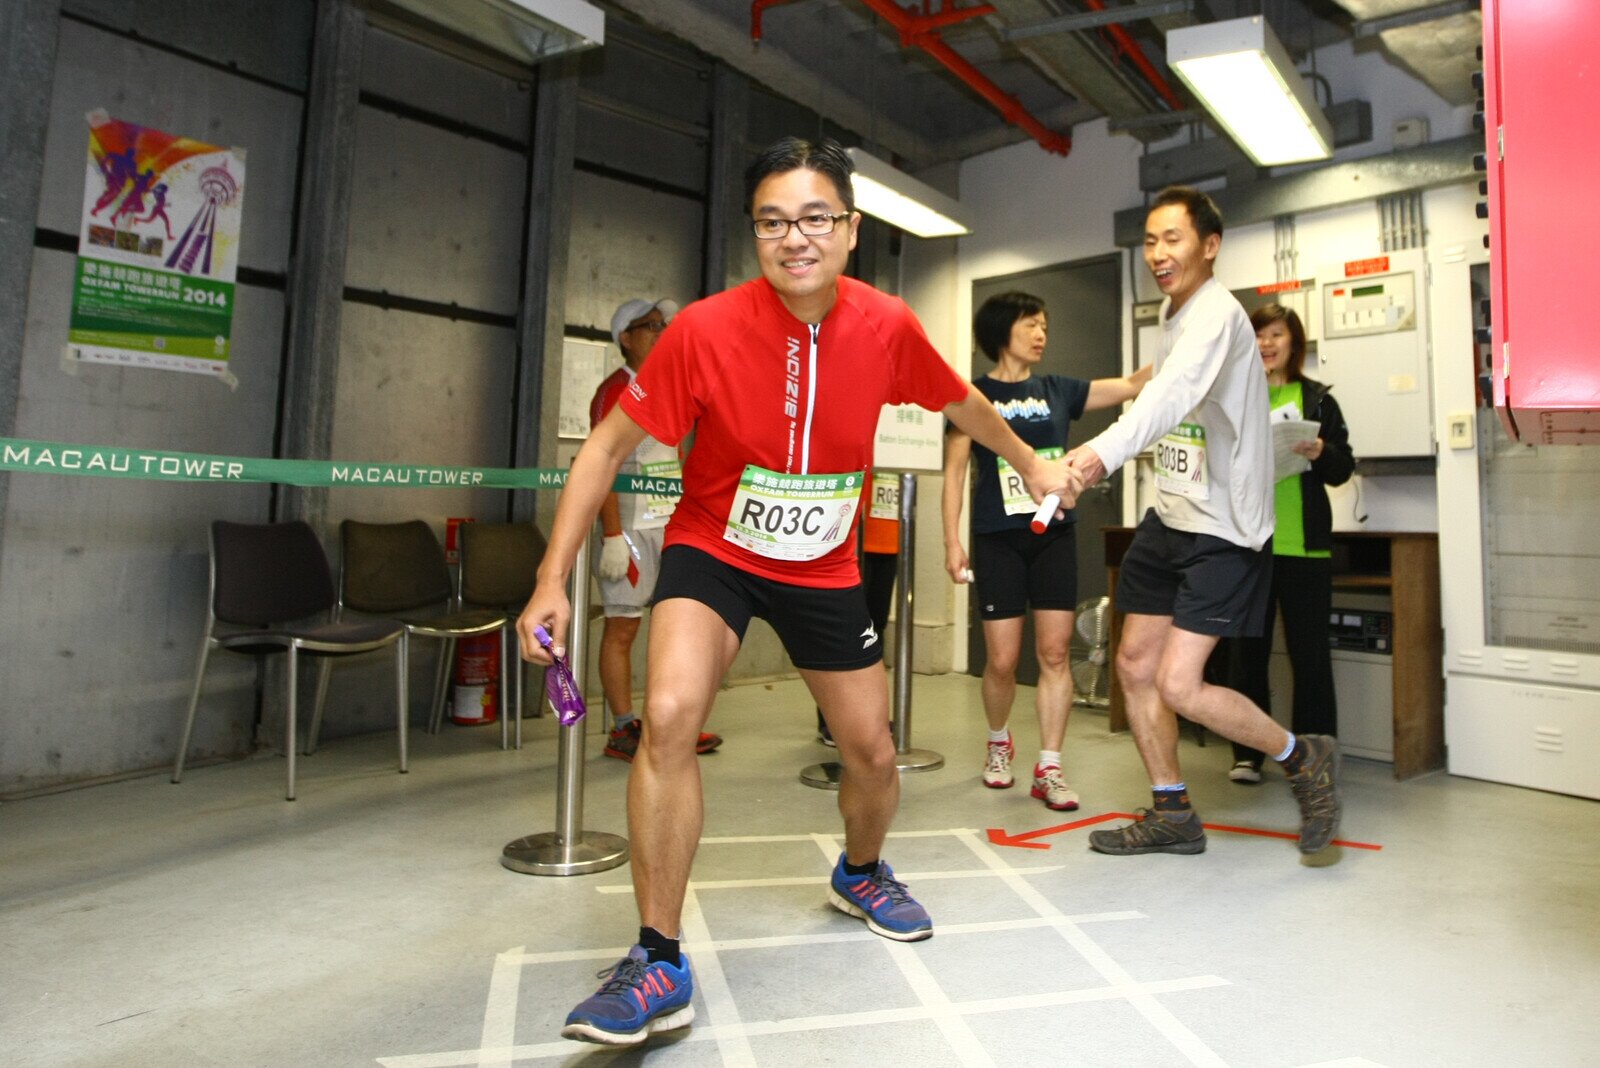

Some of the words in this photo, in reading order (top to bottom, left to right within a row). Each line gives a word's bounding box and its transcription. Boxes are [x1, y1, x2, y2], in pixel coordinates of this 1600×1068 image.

[81, 275, 121, 291] OXFAM
[123, 282, 180, 300] TOWERRUN
[183, 287, 227, 308] 2014
[3, 445, 130, 472] MACAU
[139, 455, 244, 479] TOWER
[1158, 443, 1188, 473] R03B
[332, 466, 411, 483] MACAU
[415, 469, 484, 485] TOWER
[750, 484, 785, 497] OXFAM
[786, 489, 836, 498] TOWERRUN
[876, 487, 900, 505] R05
[740, 498, 825, 536] R03C
